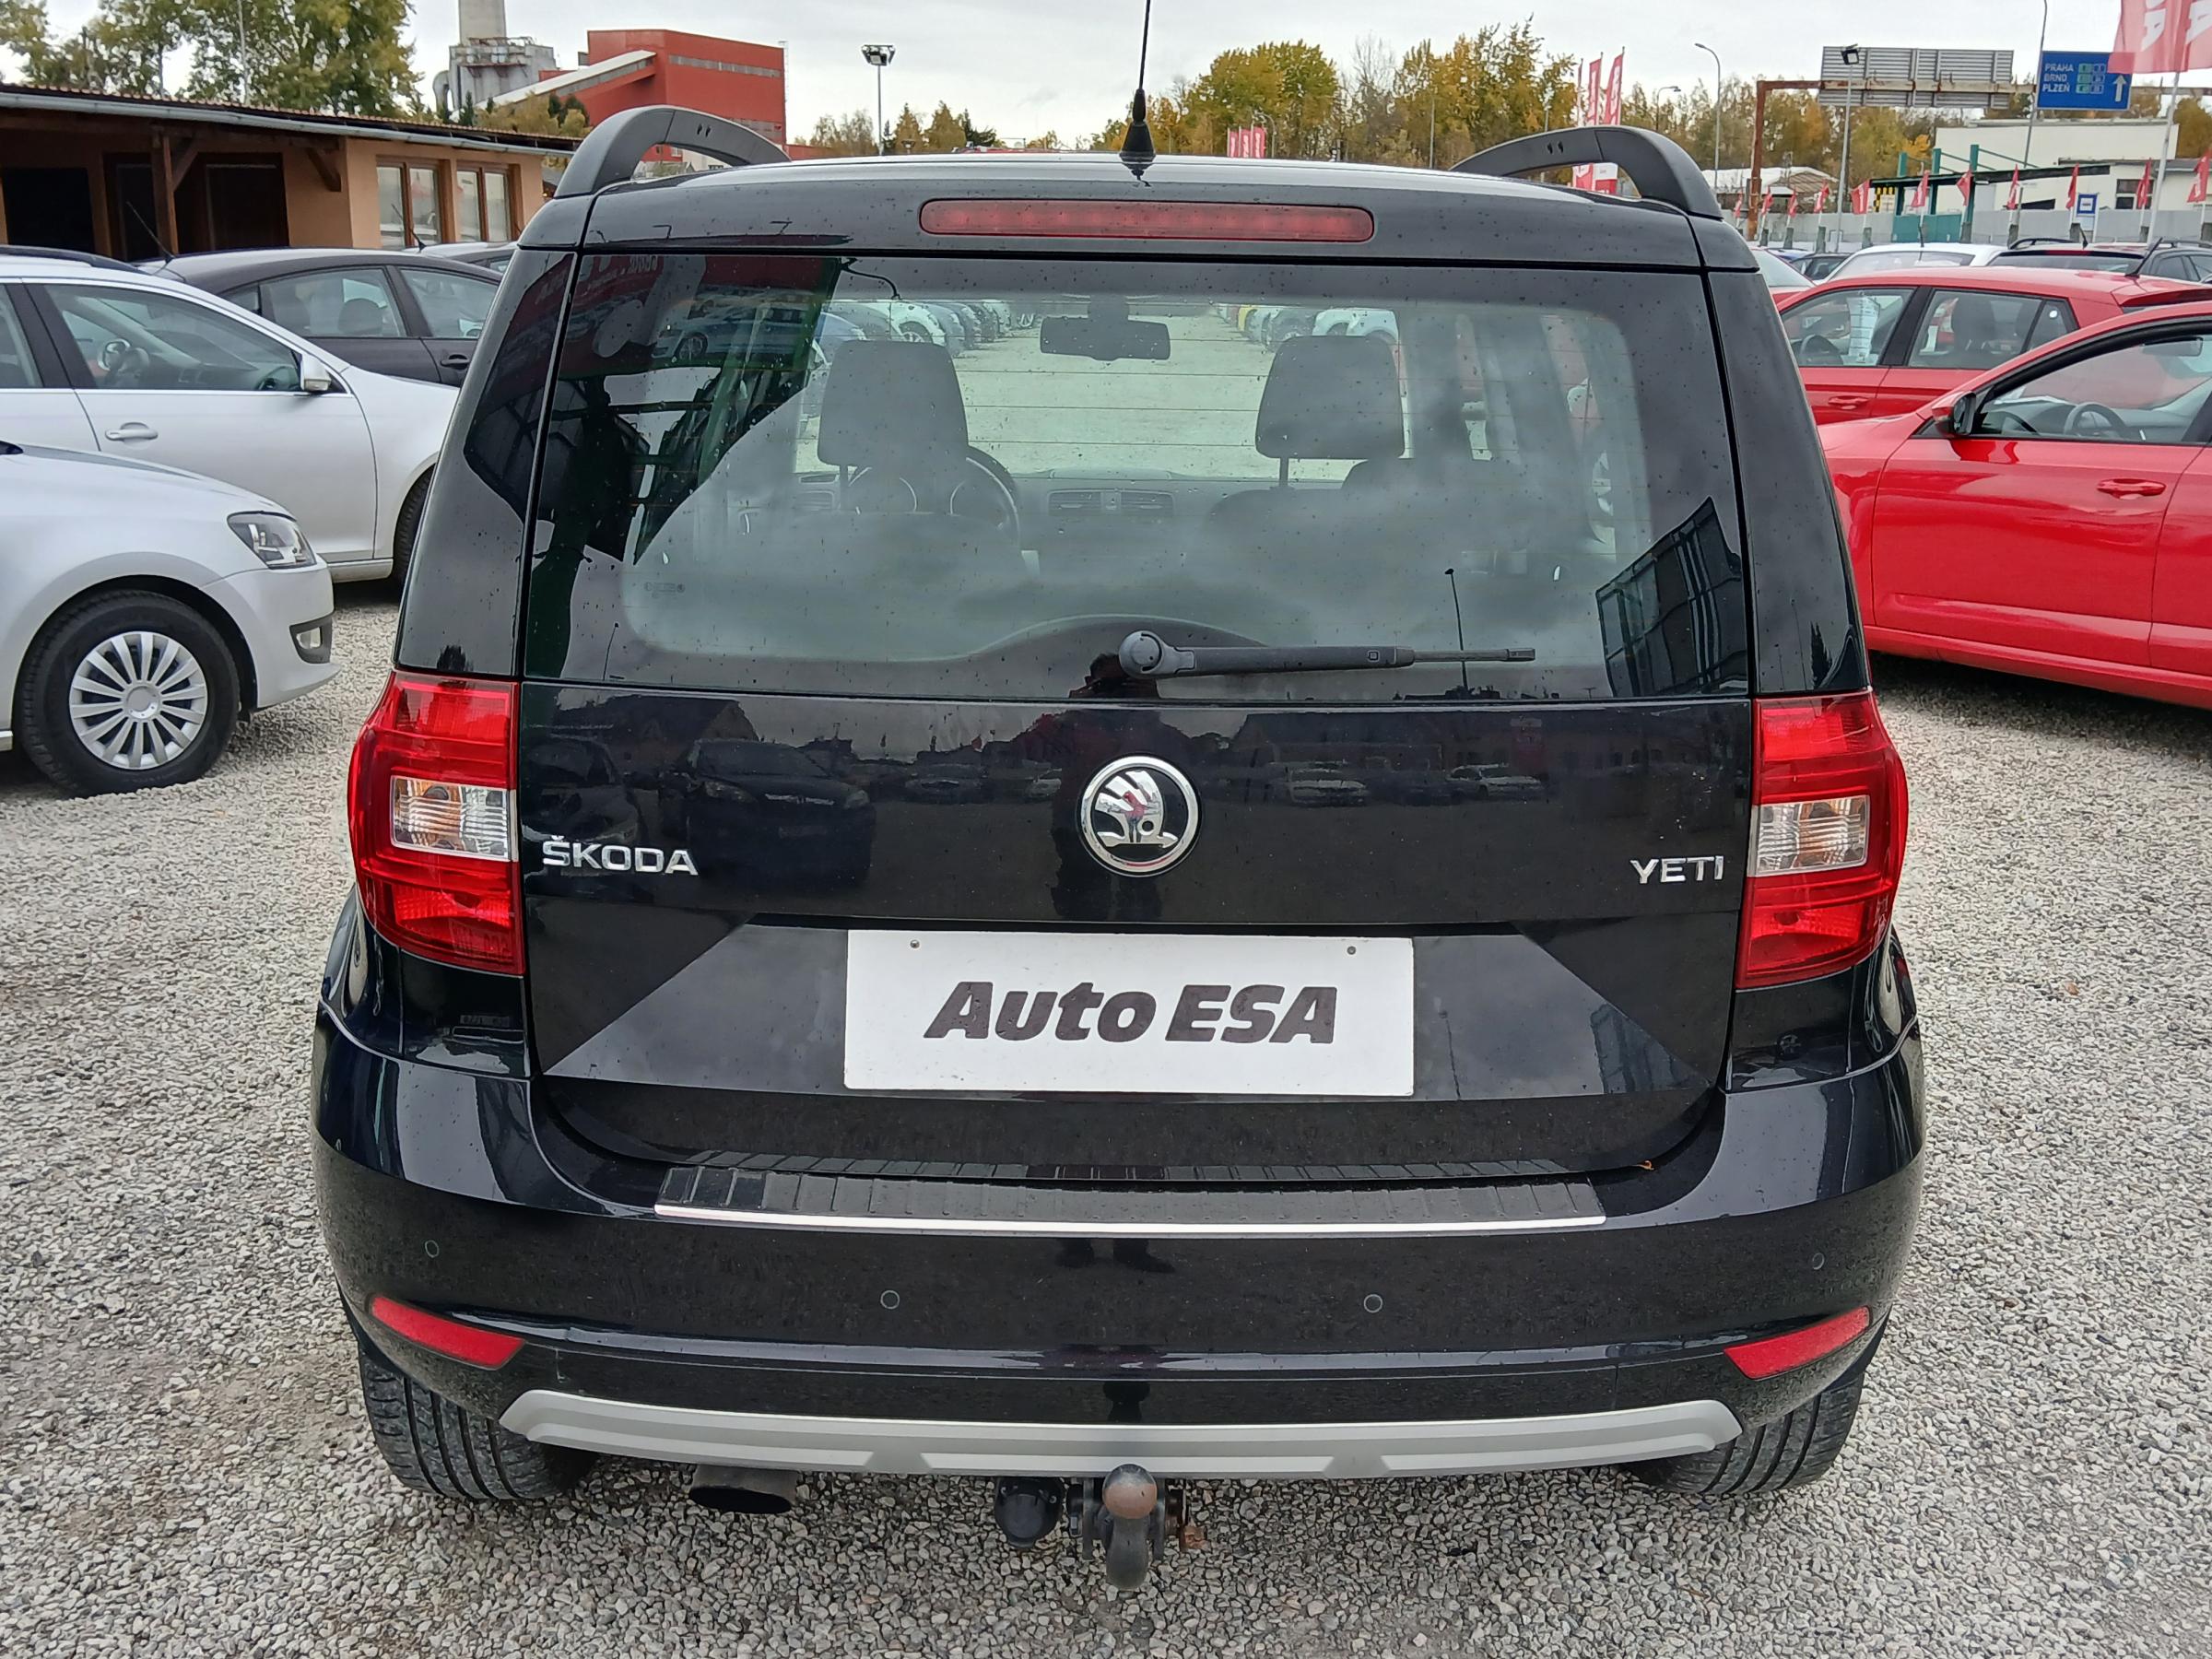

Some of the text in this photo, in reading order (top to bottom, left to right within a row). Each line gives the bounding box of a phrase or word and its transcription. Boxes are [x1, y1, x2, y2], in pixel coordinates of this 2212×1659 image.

[2044, 64, 2074, 72] PRAHA
[542, 835, 699, 876] ŠKODA
[1630, 855, 1724, 884] YETI
[924, 982, 1337, 1044] Auto ESA
